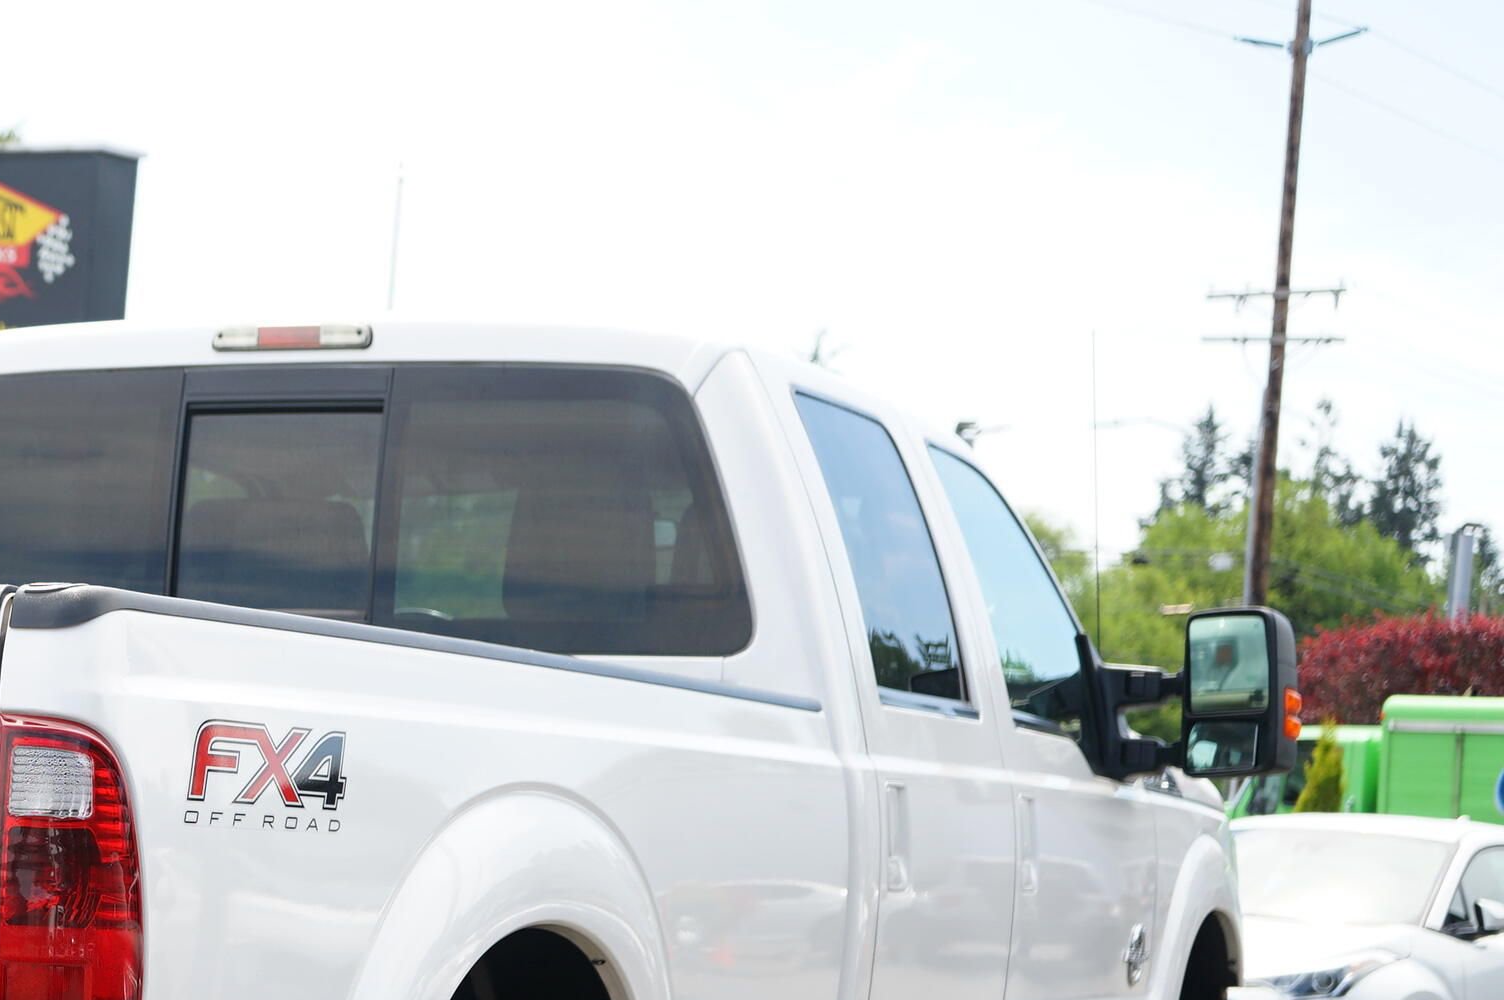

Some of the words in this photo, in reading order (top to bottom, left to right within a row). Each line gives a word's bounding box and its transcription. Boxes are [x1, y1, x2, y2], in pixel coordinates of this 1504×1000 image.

[186, 719, 347, 811] FX4
[184, 810, 246, 826] OFF
[262, 815, 341, 832] ROAD
